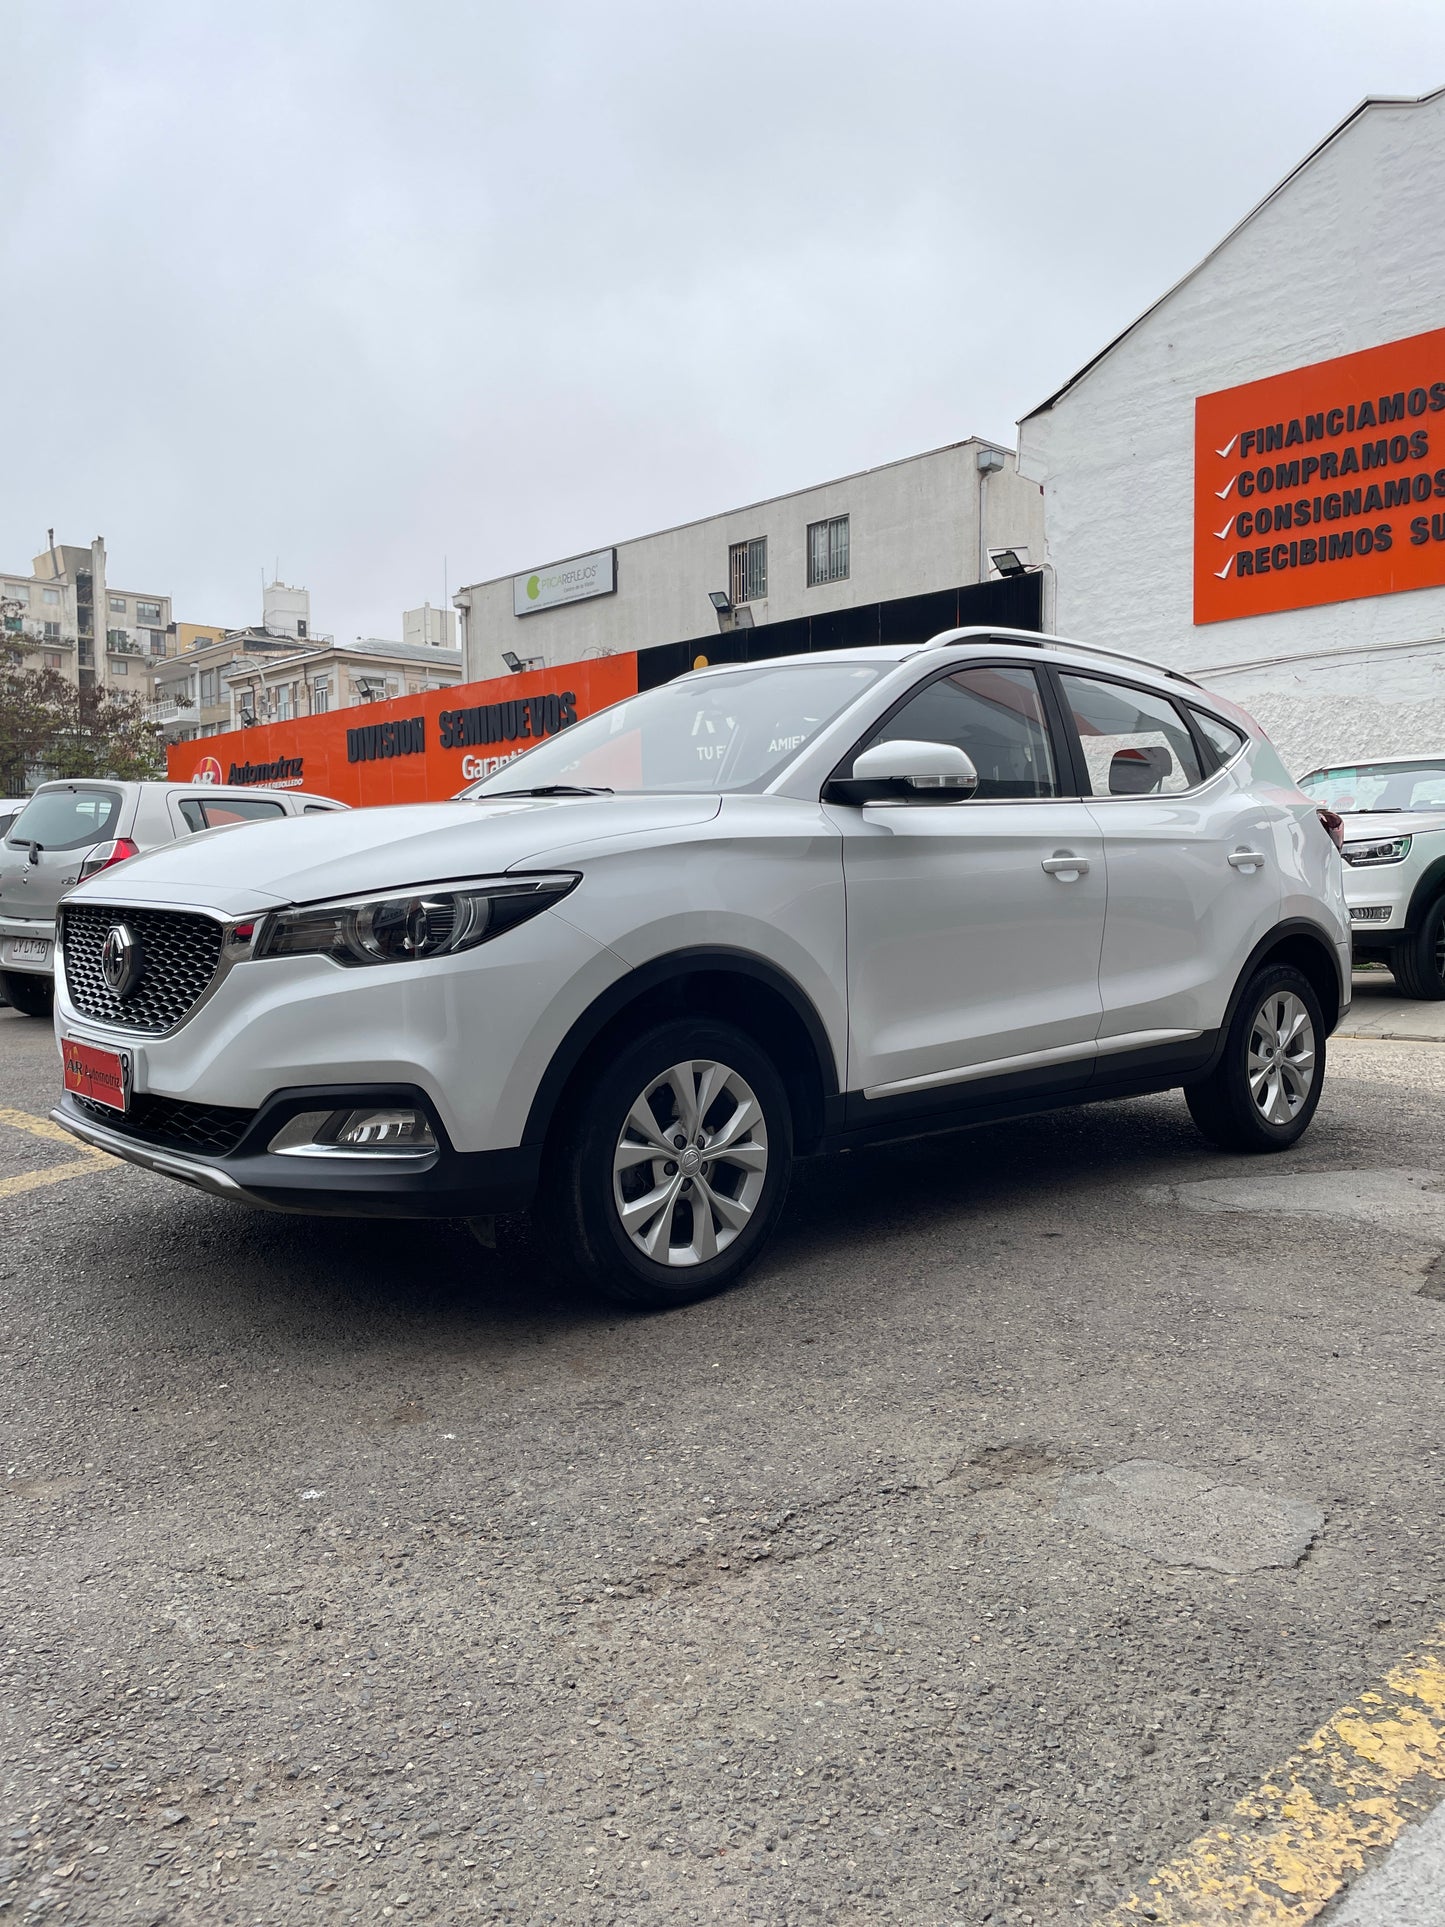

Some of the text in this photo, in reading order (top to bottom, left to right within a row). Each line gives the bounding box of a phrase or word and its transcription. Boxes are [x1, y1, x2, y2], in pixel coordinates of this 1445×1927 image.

[1239, 382, 1445, 458] FINANCIAMOS
[1237, 429, 1429, 497] COMPRAMOS
[1235, 469, 1445, 538] CONSIGNAMOS
[1236, 523, 1393, 577] RECIBIMOS
[346, 691, 578, 763] DIVISION SEMINUEVOS
[696, 746, 713, 760] TU
[227, 756, 304, 785] Automotriz
[66, 1058, 83, 1076] AR
